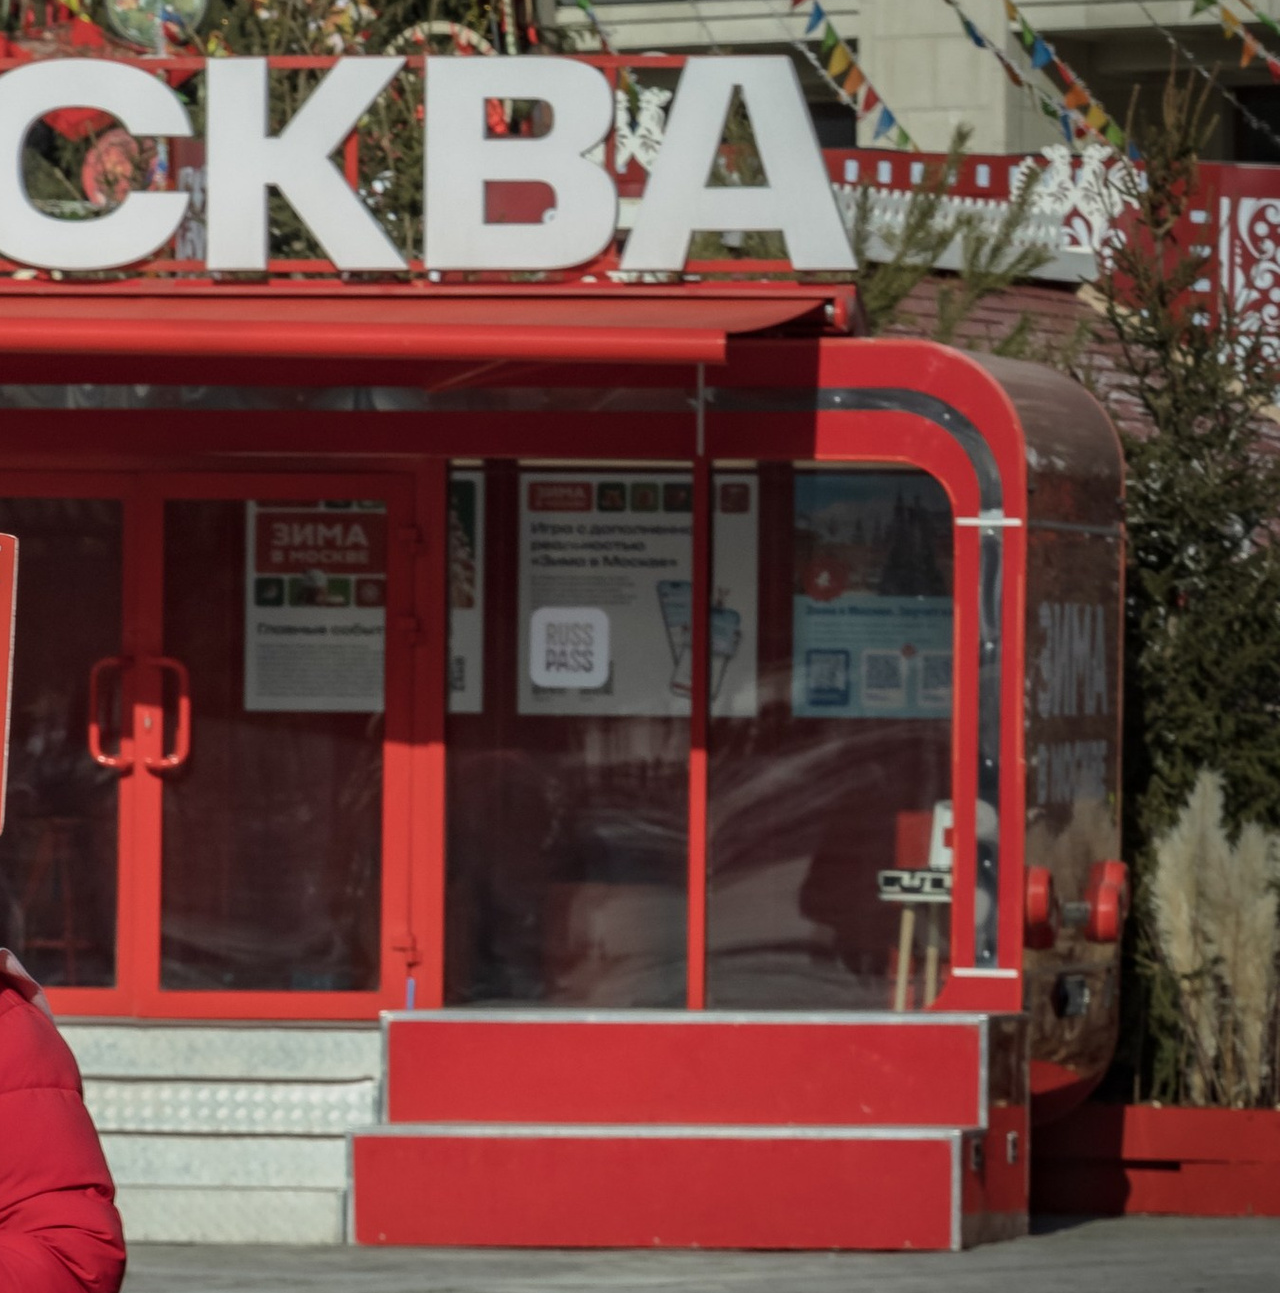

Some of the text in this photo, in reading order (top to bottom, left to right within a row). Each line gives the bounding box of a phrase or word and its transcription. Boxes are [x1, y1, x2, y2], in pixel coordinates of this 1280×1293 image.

[270, 522, 369, 547] ЗИМА
[545, 622, 595, 647] RUSS
[544, 649, 594, 673] PASS
